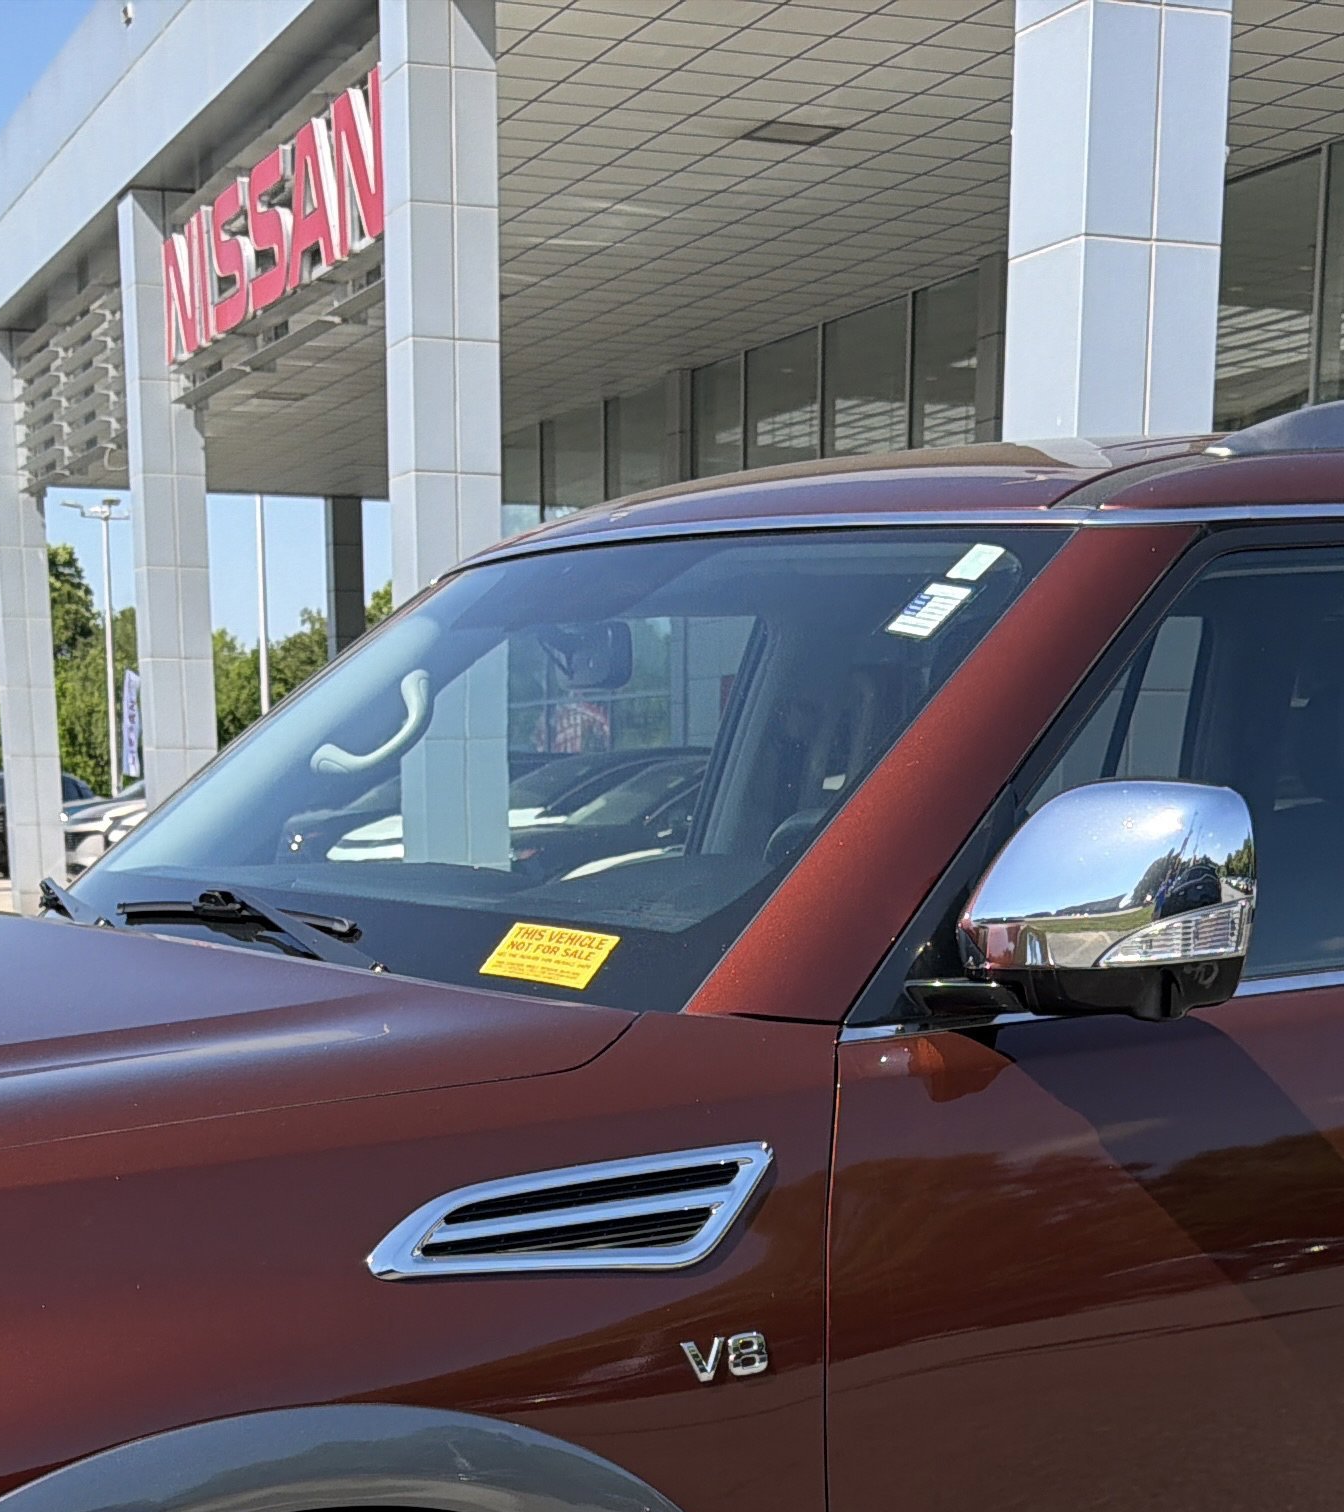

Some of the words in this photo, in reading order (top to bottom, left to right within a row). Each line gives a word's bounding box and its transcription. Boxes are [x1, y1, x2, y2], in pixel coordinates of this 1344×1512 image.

[162, 63, 384, 366] NISSAN
[506, 940, 531, 951] NOT
[533, 943, 561, 955] FOR
[561, 947, 596, 962] SALE
[514, 926, 547, 941] THIS
[548, 930, 609, 951] VEHICLE
[680, 1331, 769, 1383] V8
